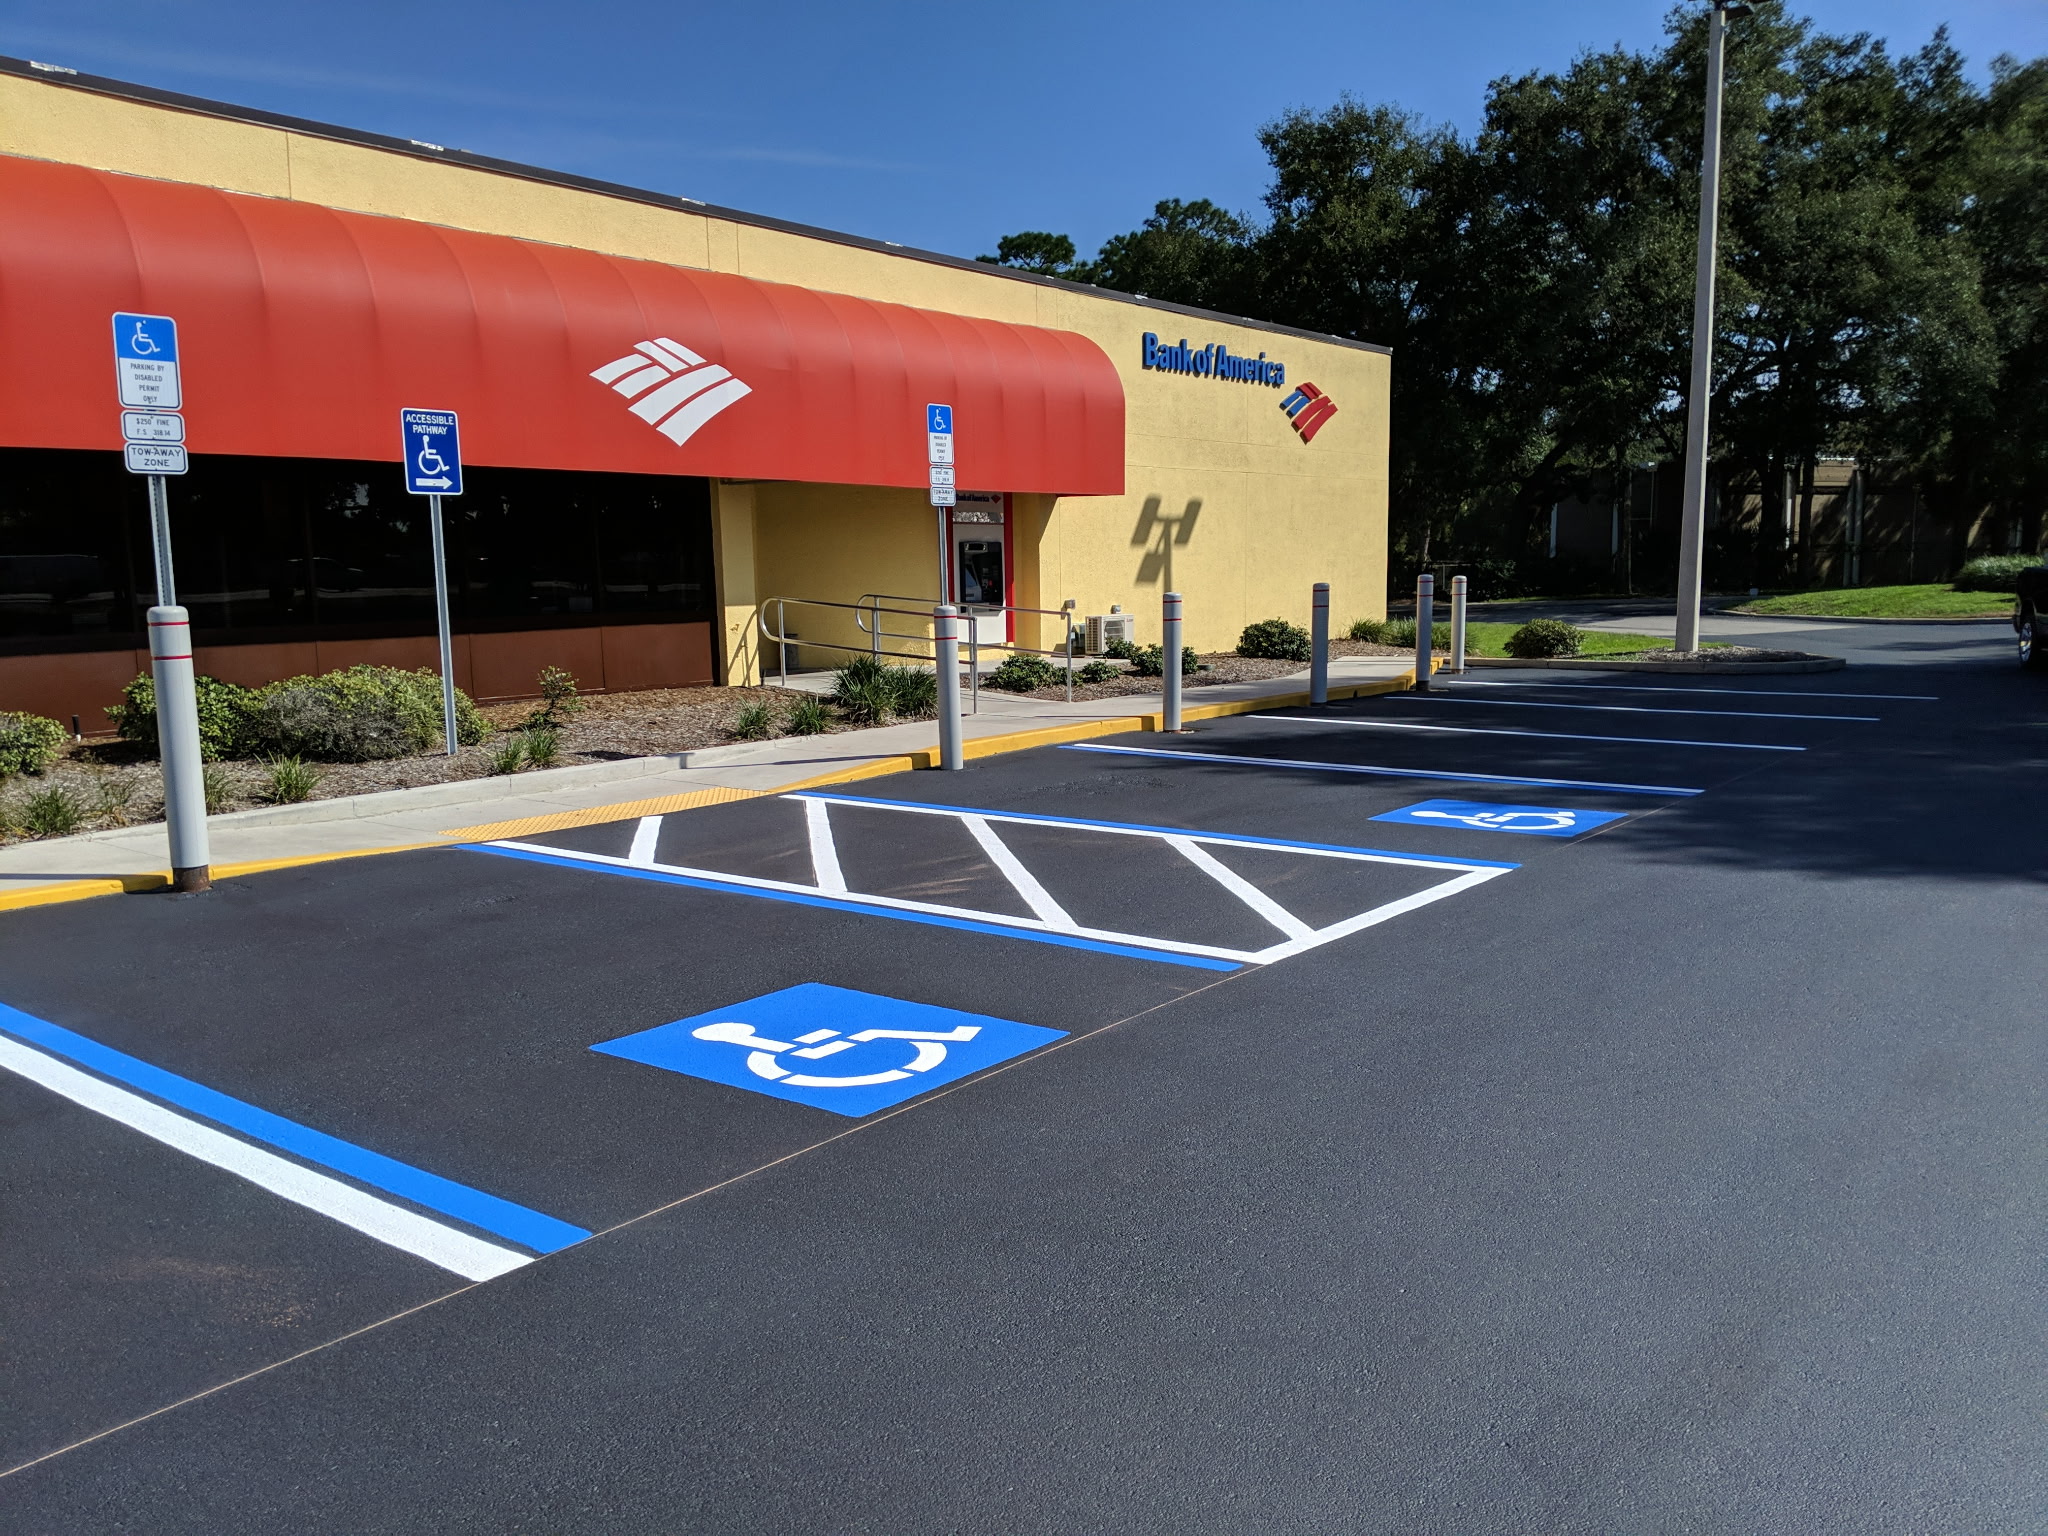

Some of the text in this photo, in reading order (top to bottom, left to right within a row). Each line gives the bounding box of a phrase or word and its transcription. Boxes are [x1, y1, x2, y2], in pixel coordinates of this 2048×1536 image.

[1142, 332, 1285, 384] Bank of America
[130, 362, 165, 372] PARKING BY
[134, 374, 163, 382] DISABLED
[139, 384, 160, 392] PERMIT
[136, 417, 170, 426] $250 FINE
[405, 414, 454, 425] ACCESSIBLE
[412, 424, 448, 435] PATHWAY
[131, 447, 181, 457] TOW-AWAY
[144, 458, 170, 467] ZONE
